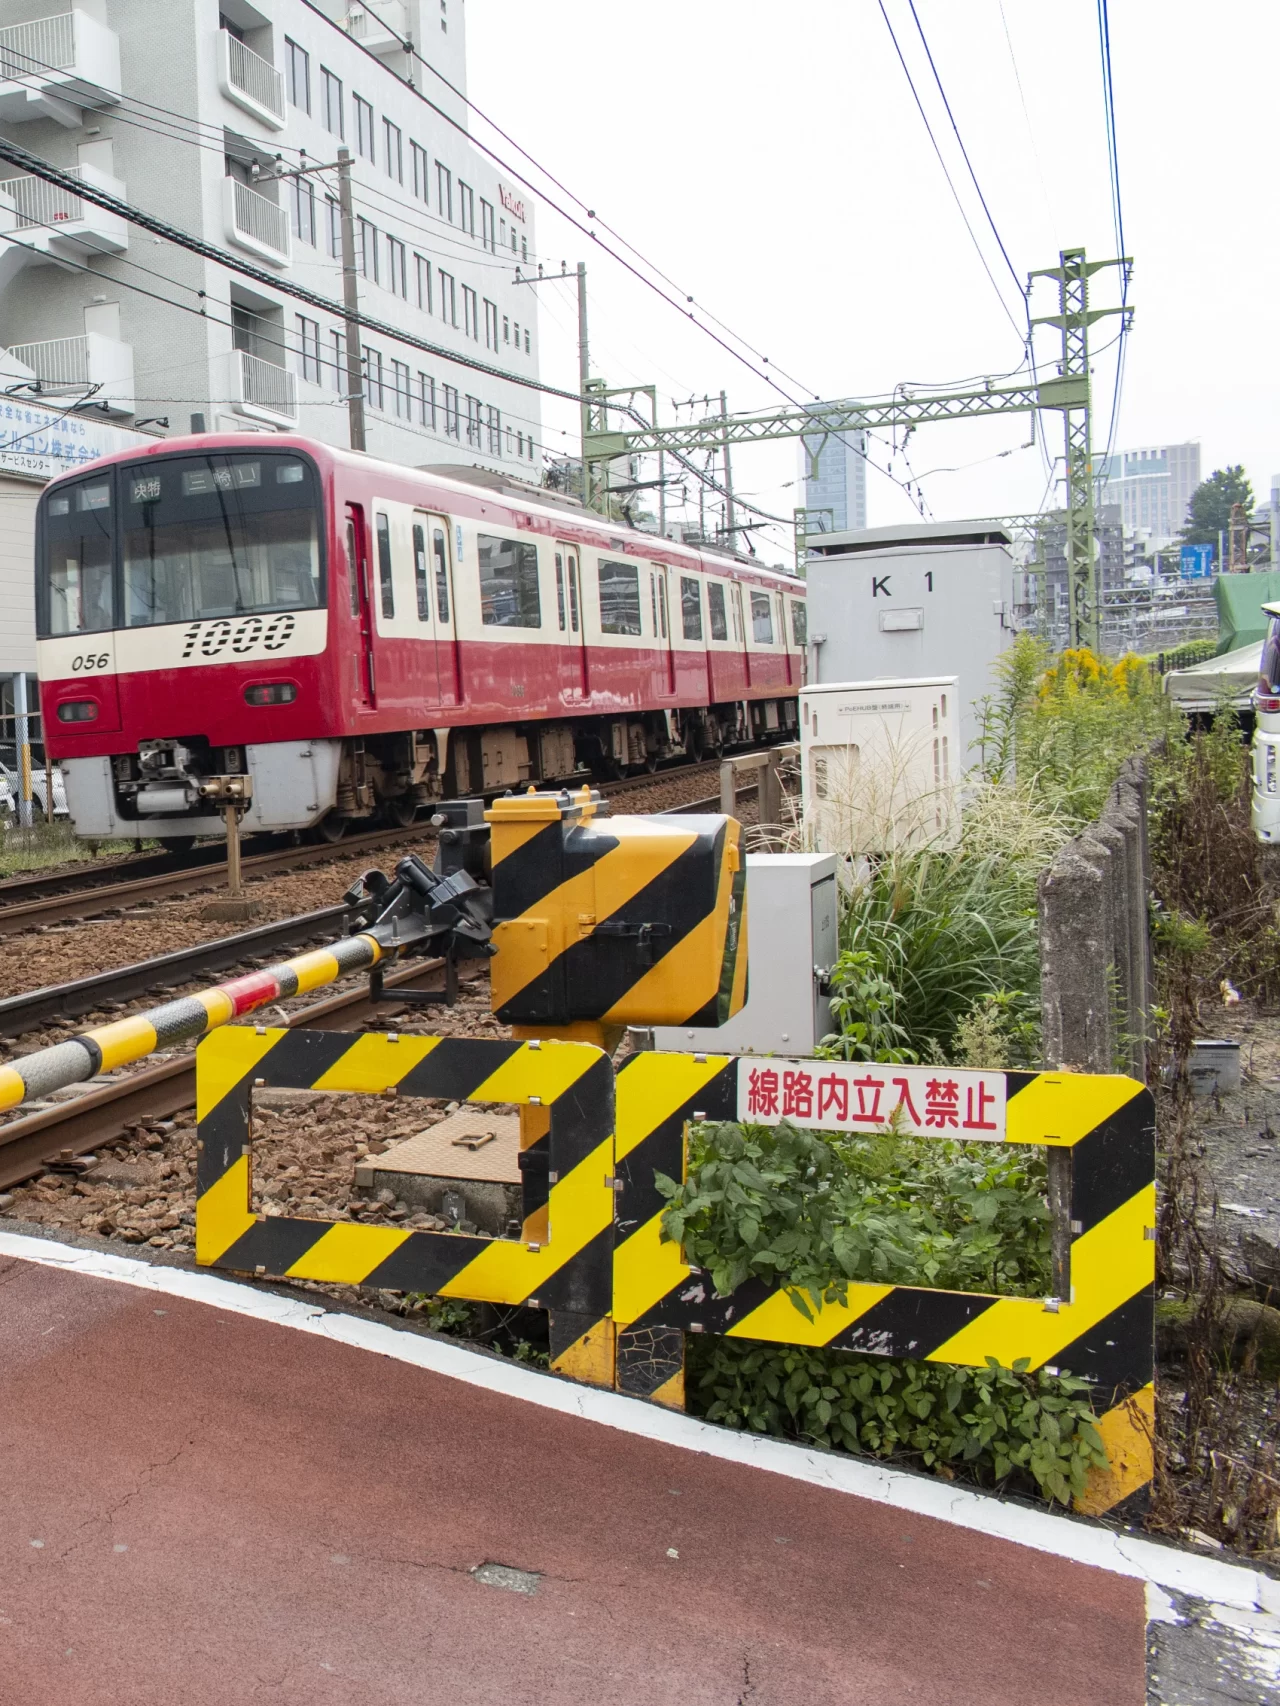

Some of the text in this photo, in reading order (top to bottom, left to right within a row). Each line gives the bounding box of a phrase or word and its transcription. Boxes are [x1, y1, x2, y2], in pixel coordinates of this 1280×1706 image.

[181, 614, 296, 658] 1000
[71, 652, 110, 671] 056
[747, 1067, 997, 1130] 線路内立入禁止
